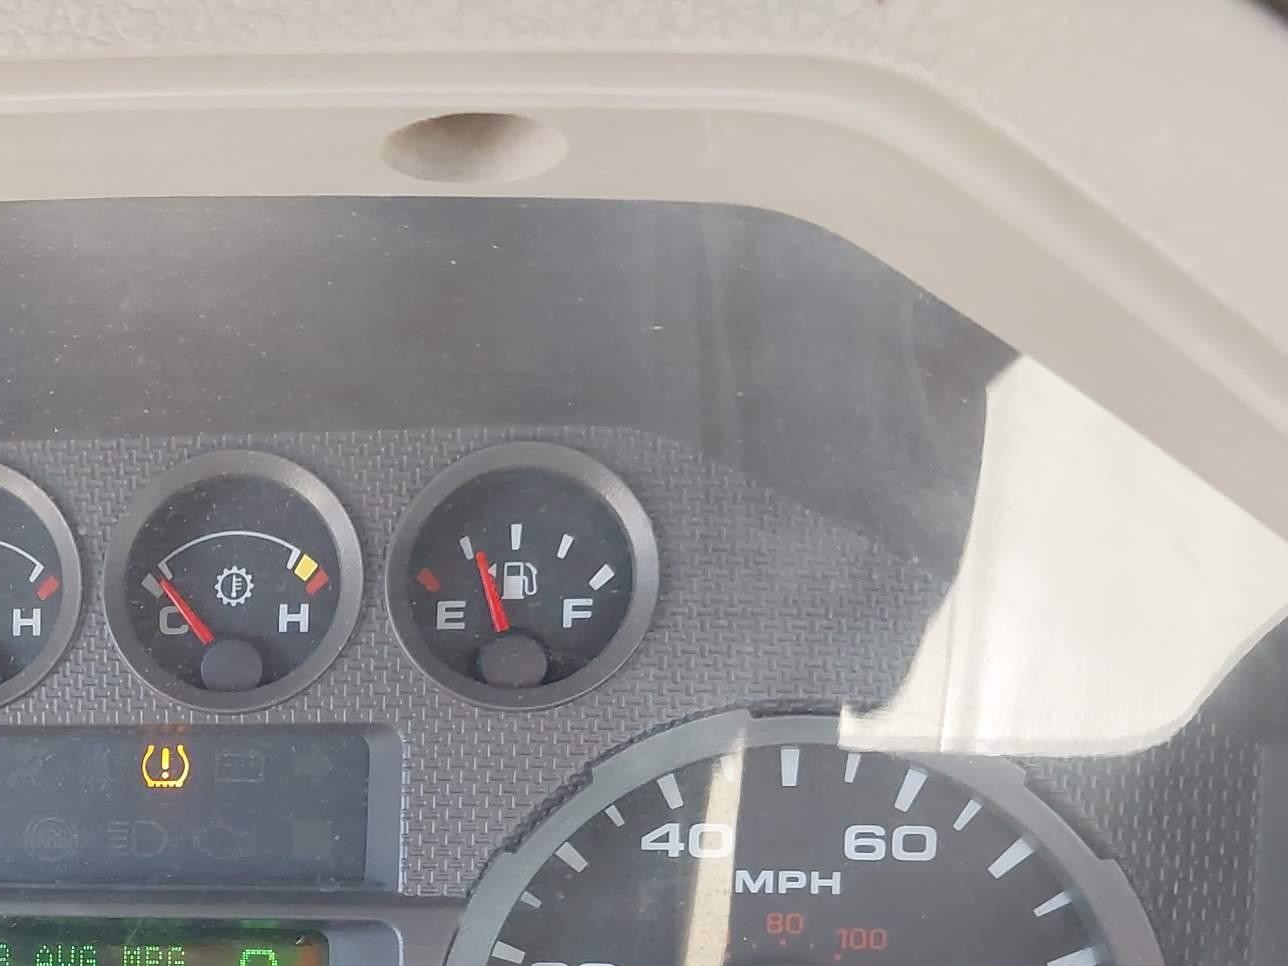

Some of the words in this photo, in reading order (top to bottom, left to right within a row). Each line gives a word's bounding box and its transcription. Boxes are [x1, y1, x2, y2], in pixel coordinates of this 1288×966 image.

[13, 609, 40, 636] H
[160, 606, 190, 635] C
[279, 604, 309, 632] H
[437, 601, 466, 629] E
[563, 599, 593, 628] F
[641, 822, 733, 858] 40
[845, 825, 937, 860] 60
[734, 870, 842, 895] MPH
[766, 912, 804, 935] 80
[836, 928, 889, 949] 100
